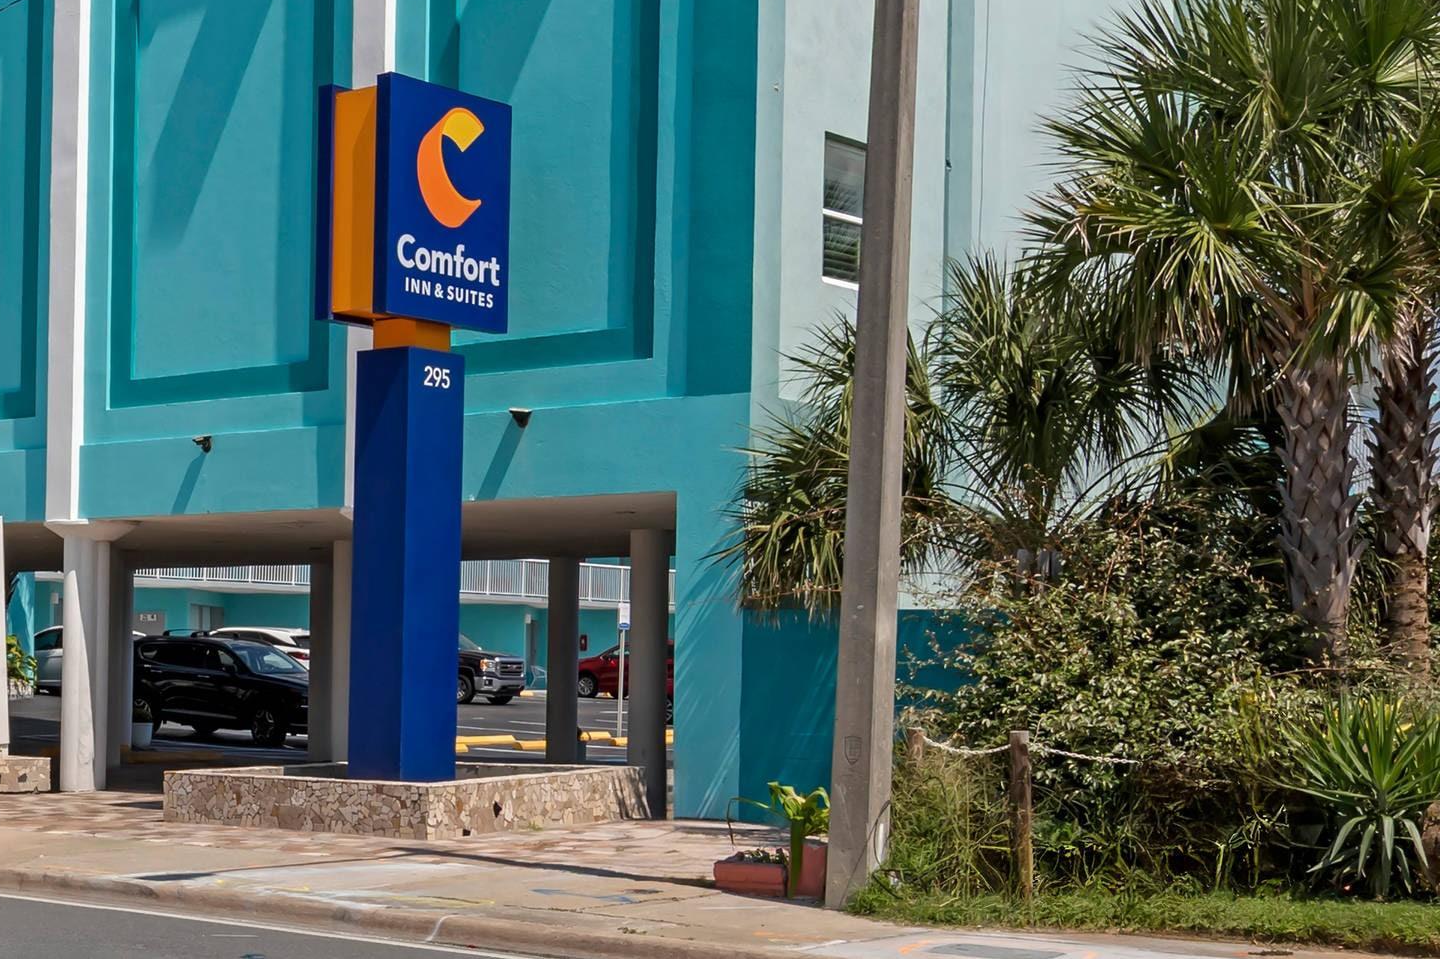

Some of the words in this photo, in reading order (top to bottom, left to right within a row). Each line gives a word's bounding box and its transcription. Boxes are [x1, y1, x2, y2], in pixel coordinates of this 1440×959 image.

[397, 233, 500, 287] Comfort
[405, 276, 431, 296] INN
[434, 283, 444, 299] &
[447, 285, 494, 309] SUITES
[423, 365, 451, 390] 295
